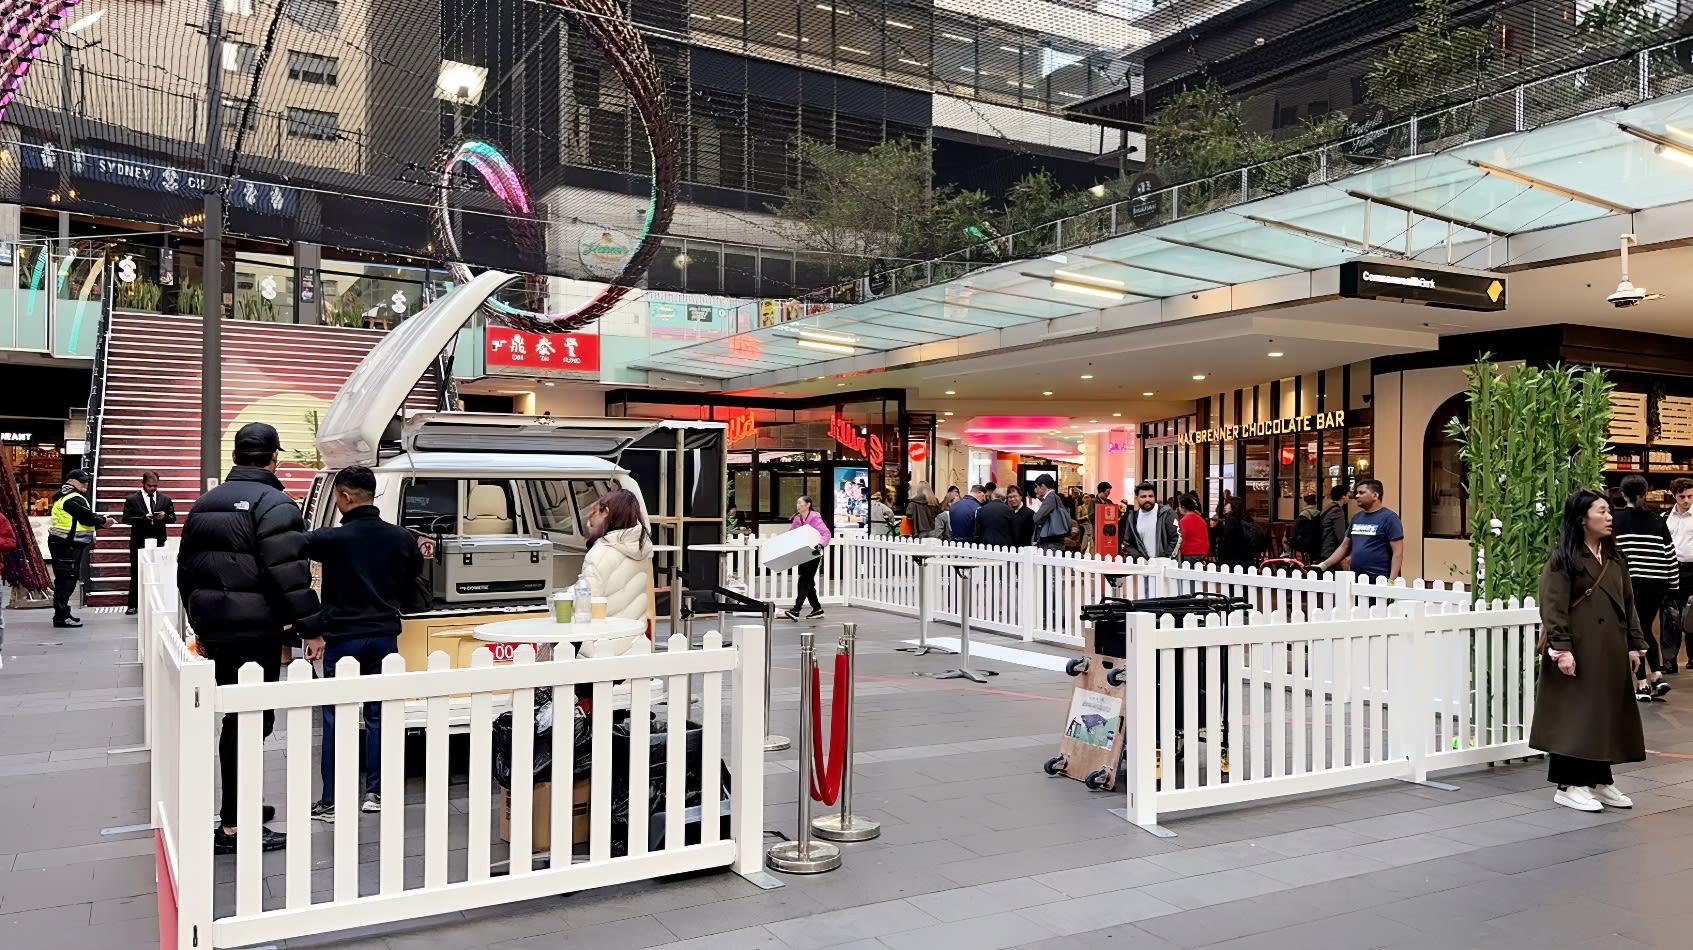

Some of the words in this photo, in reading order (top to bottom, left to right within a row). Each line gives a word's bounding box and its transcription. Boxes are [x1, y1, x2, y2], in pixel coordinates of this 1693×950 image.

[99, 159, 151, 180] SYDNEY
[1195, 424, 1239, 444] BRENNER
[1242, 414, 1312, 438] CHOCOLATE
[1316, 409, 1345, 429] BAR
